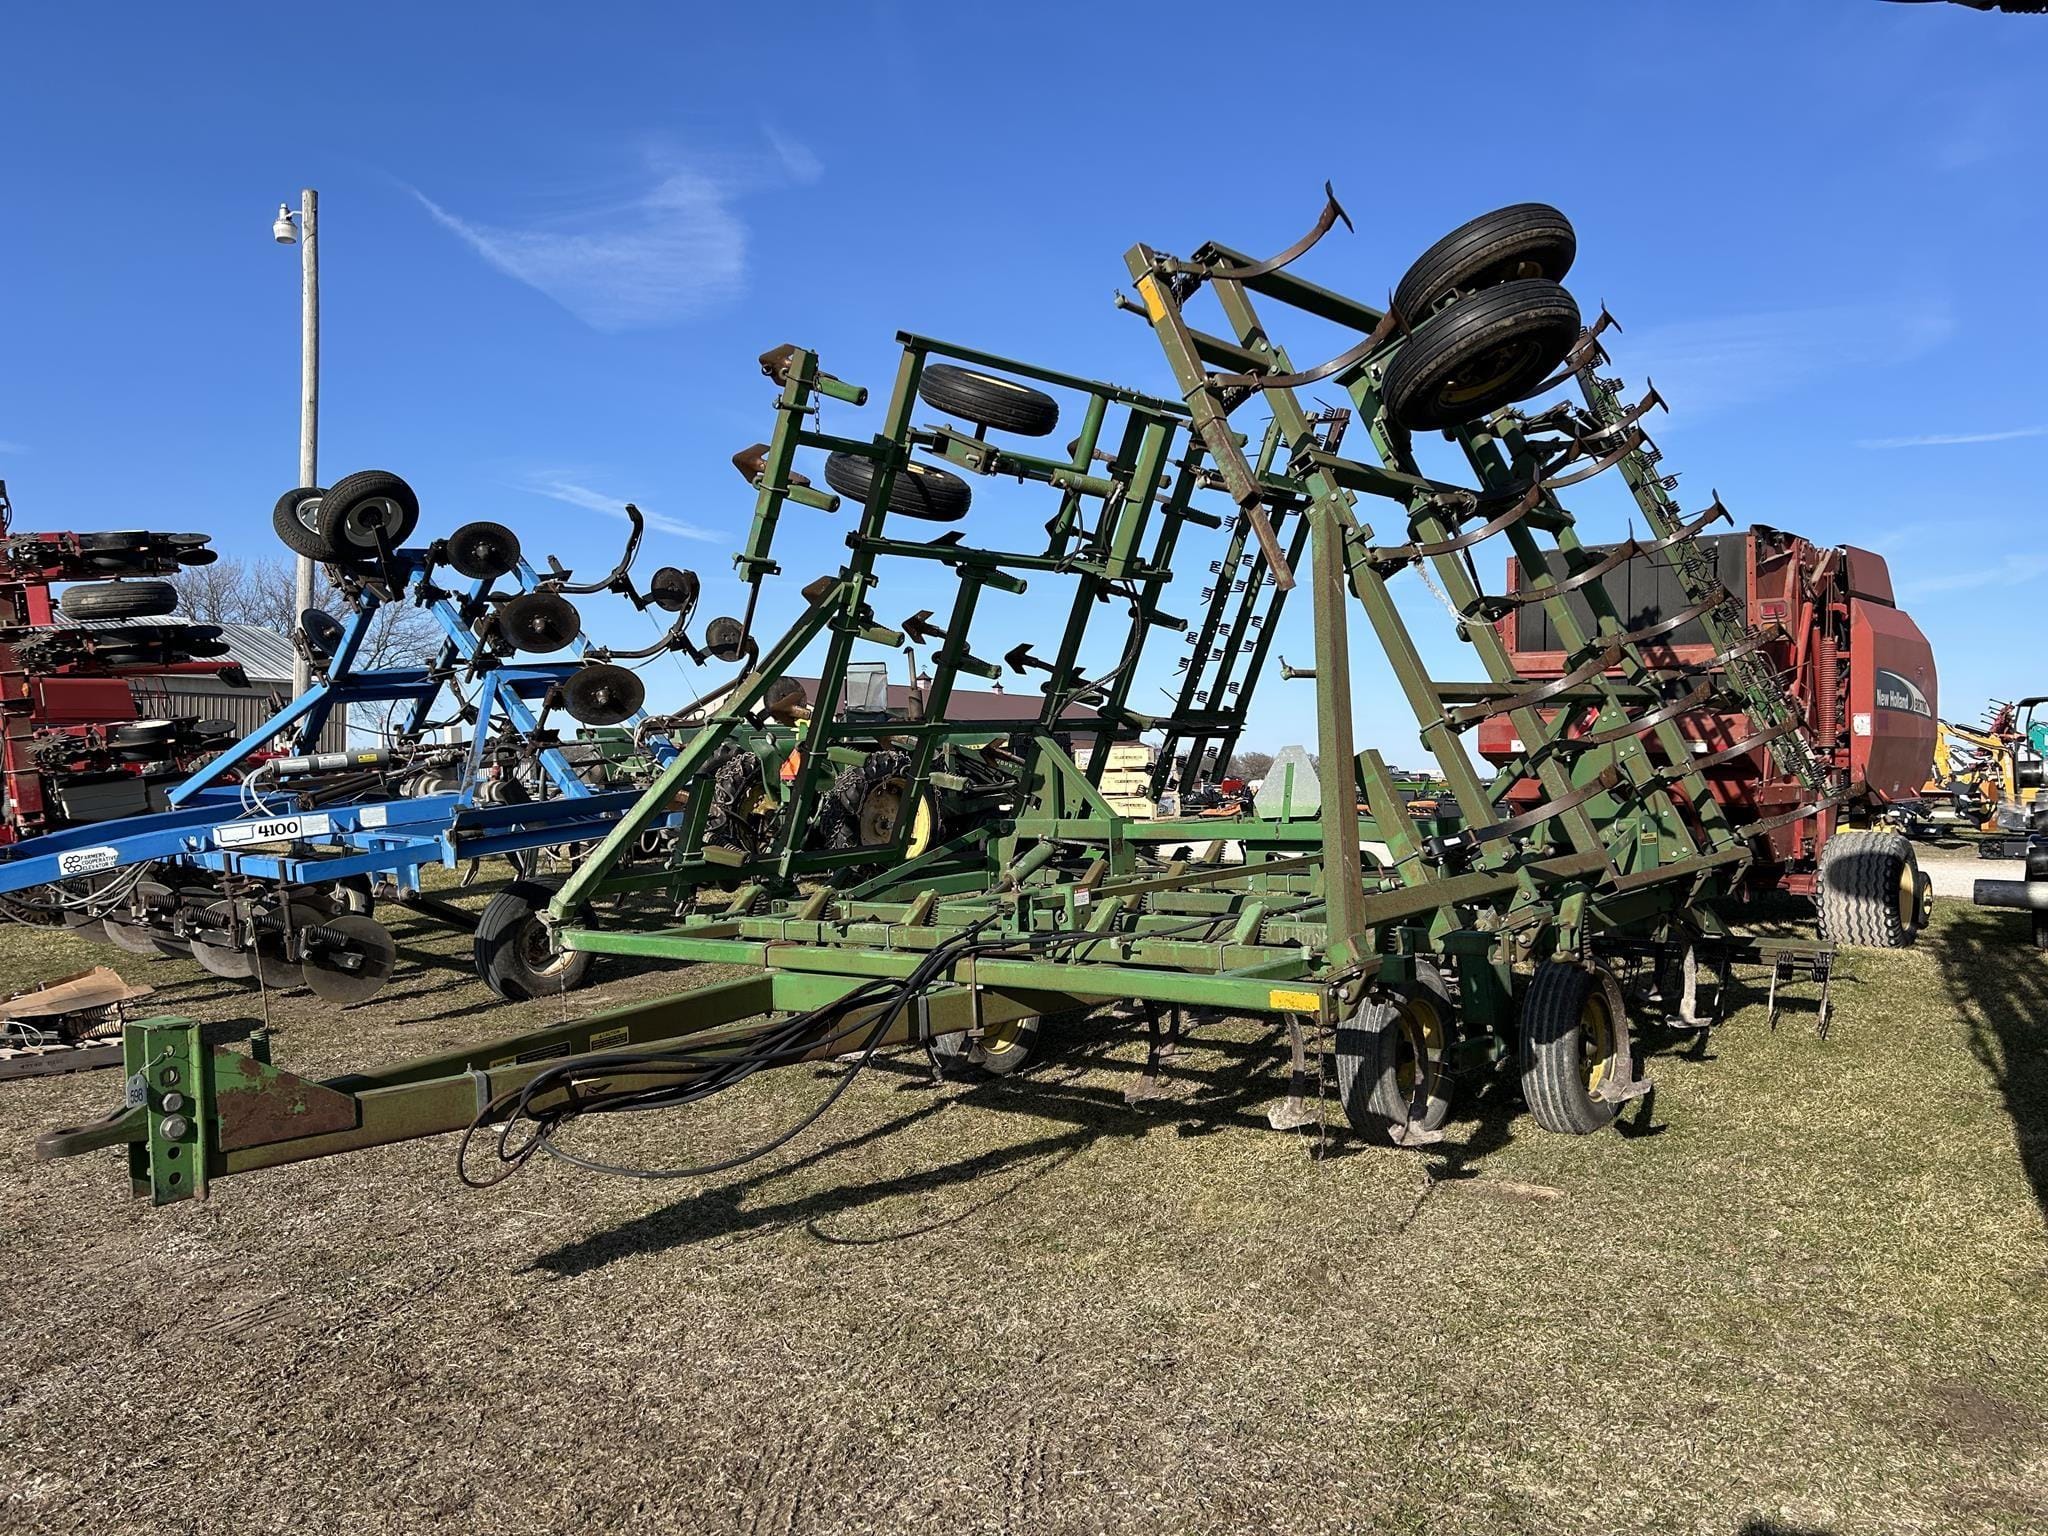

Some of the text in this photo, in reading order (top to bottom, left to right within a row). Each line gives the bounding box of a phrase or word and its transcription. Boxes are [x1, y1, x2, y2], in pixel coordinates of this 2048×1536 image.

[1876, 688, 1909, 709] New Holland
[258, 821, 299, 837] 4100
[81, 852, 106, 860] FARMERS
[82, 862, 109, 871] ELEVATOR
[130, 1087, 144, 1104] 598
